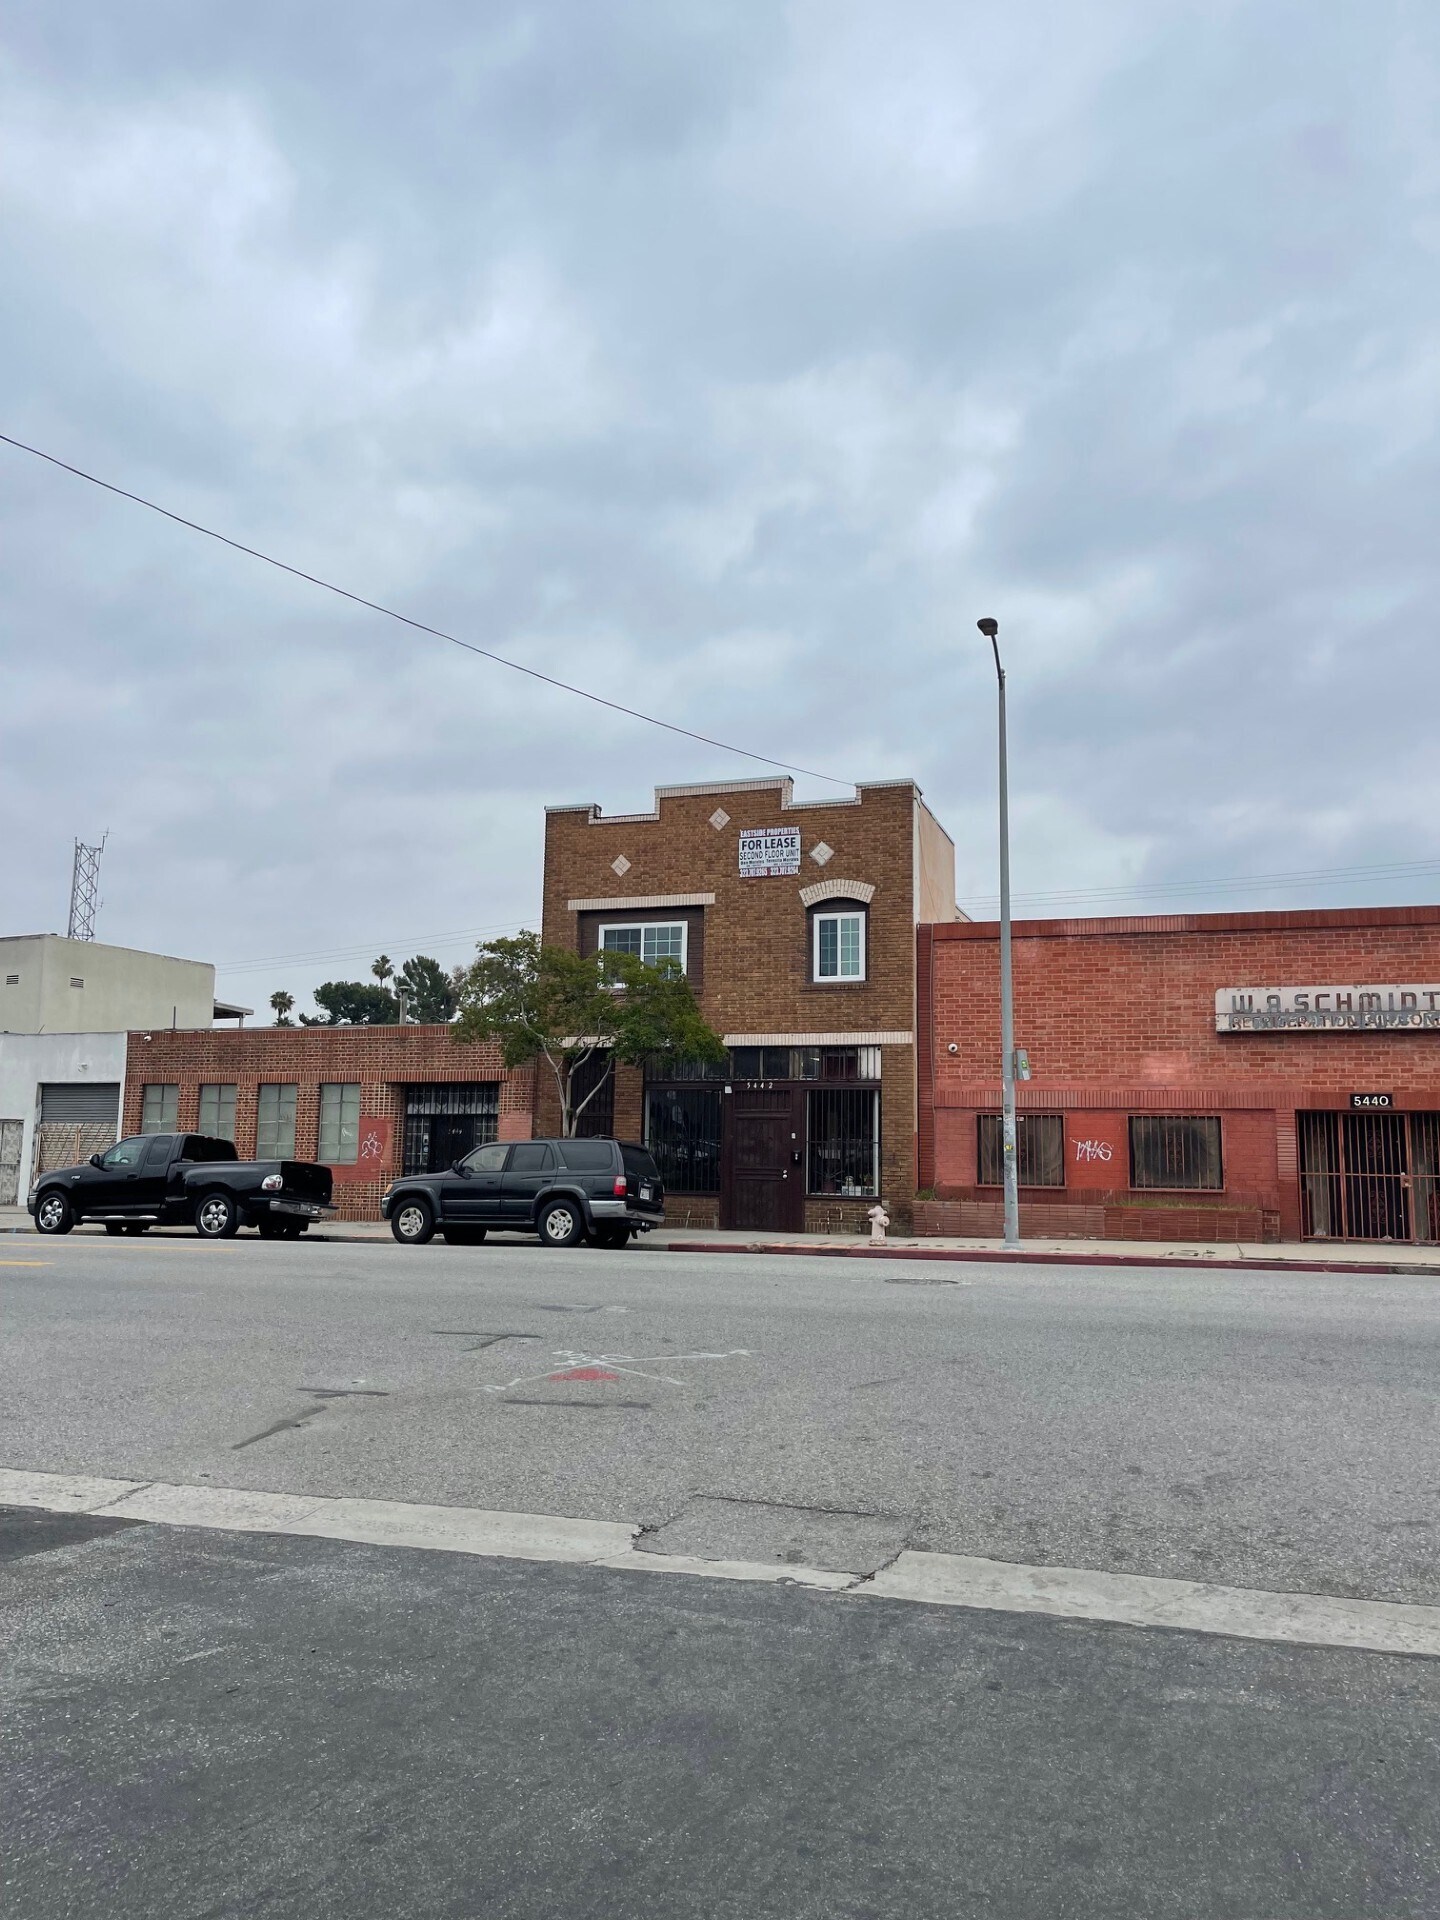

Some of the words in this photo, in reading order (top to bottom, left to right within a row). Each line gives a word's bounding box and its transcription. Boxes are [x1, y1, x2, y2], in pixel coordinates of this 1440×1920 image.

[767, 827, 799, 835] PROPERTIES
[741, 839, 762, 850] FOR
[764, 837, 796, 849] LEASE
[740, 851, 763, 860] SECOND
[765, 849, 784, 858] FLOOR
[786, 848, 799, 857] UNIT
[746, 1081, 773, 1089] 5442
[1353, 1095, 1389, 1106] 5440
